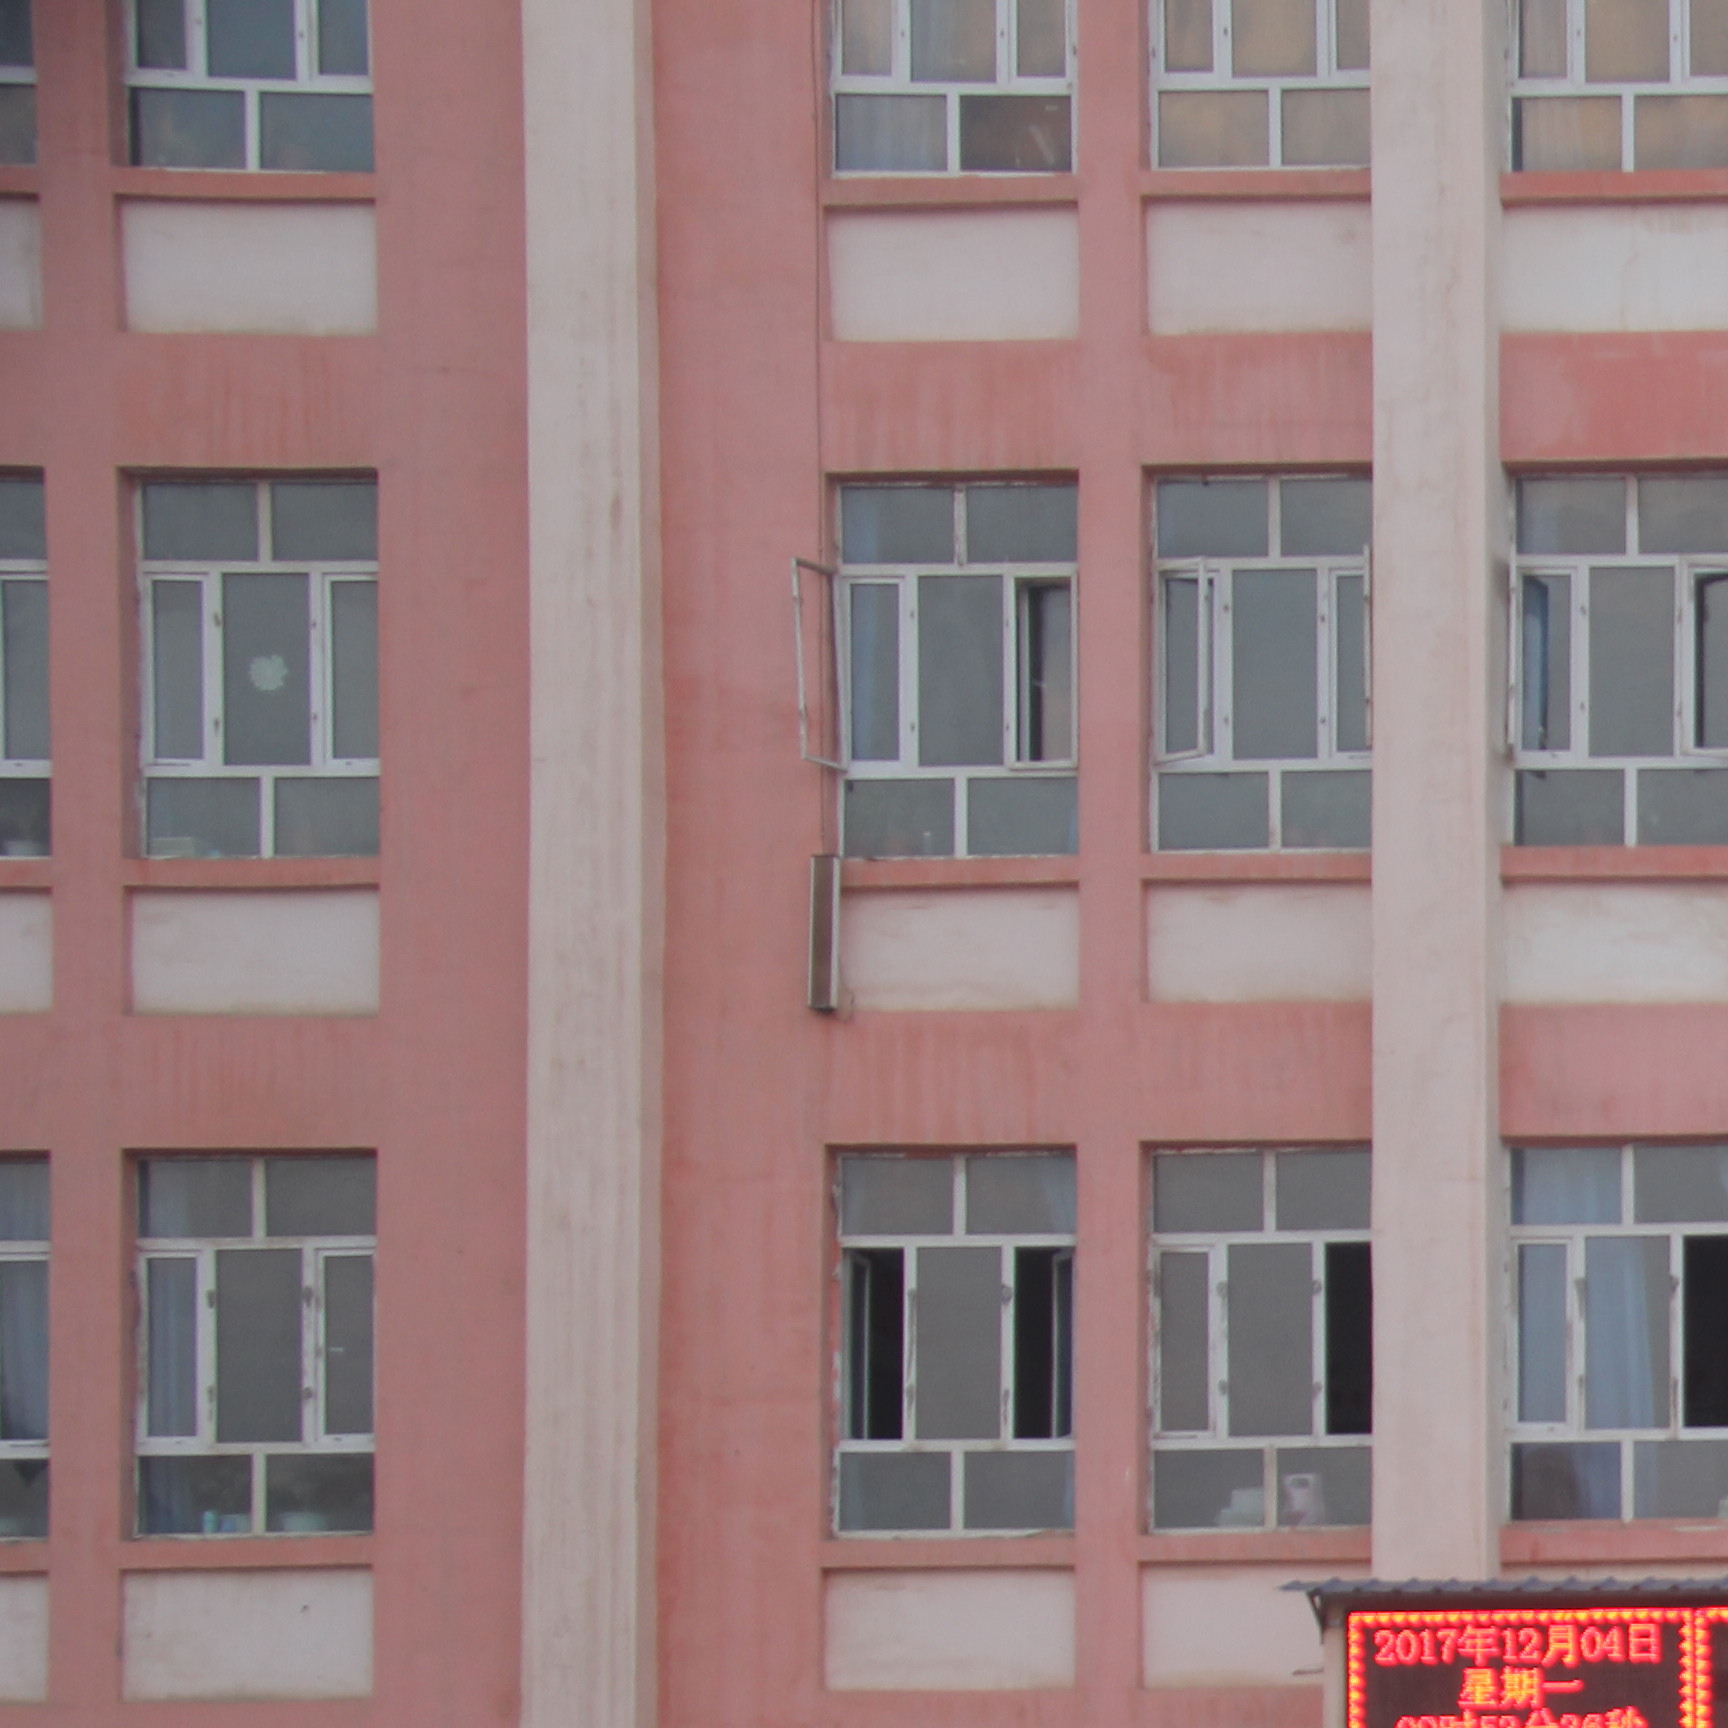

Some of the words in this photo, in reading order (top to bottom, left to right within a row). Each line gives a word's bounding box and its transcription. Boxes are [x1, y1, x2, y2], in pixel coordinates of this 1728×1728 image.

[1373, 1624, 1662, 1668] 2017年12月04日
[1458, 1666, 1584, 1709] 星期一
